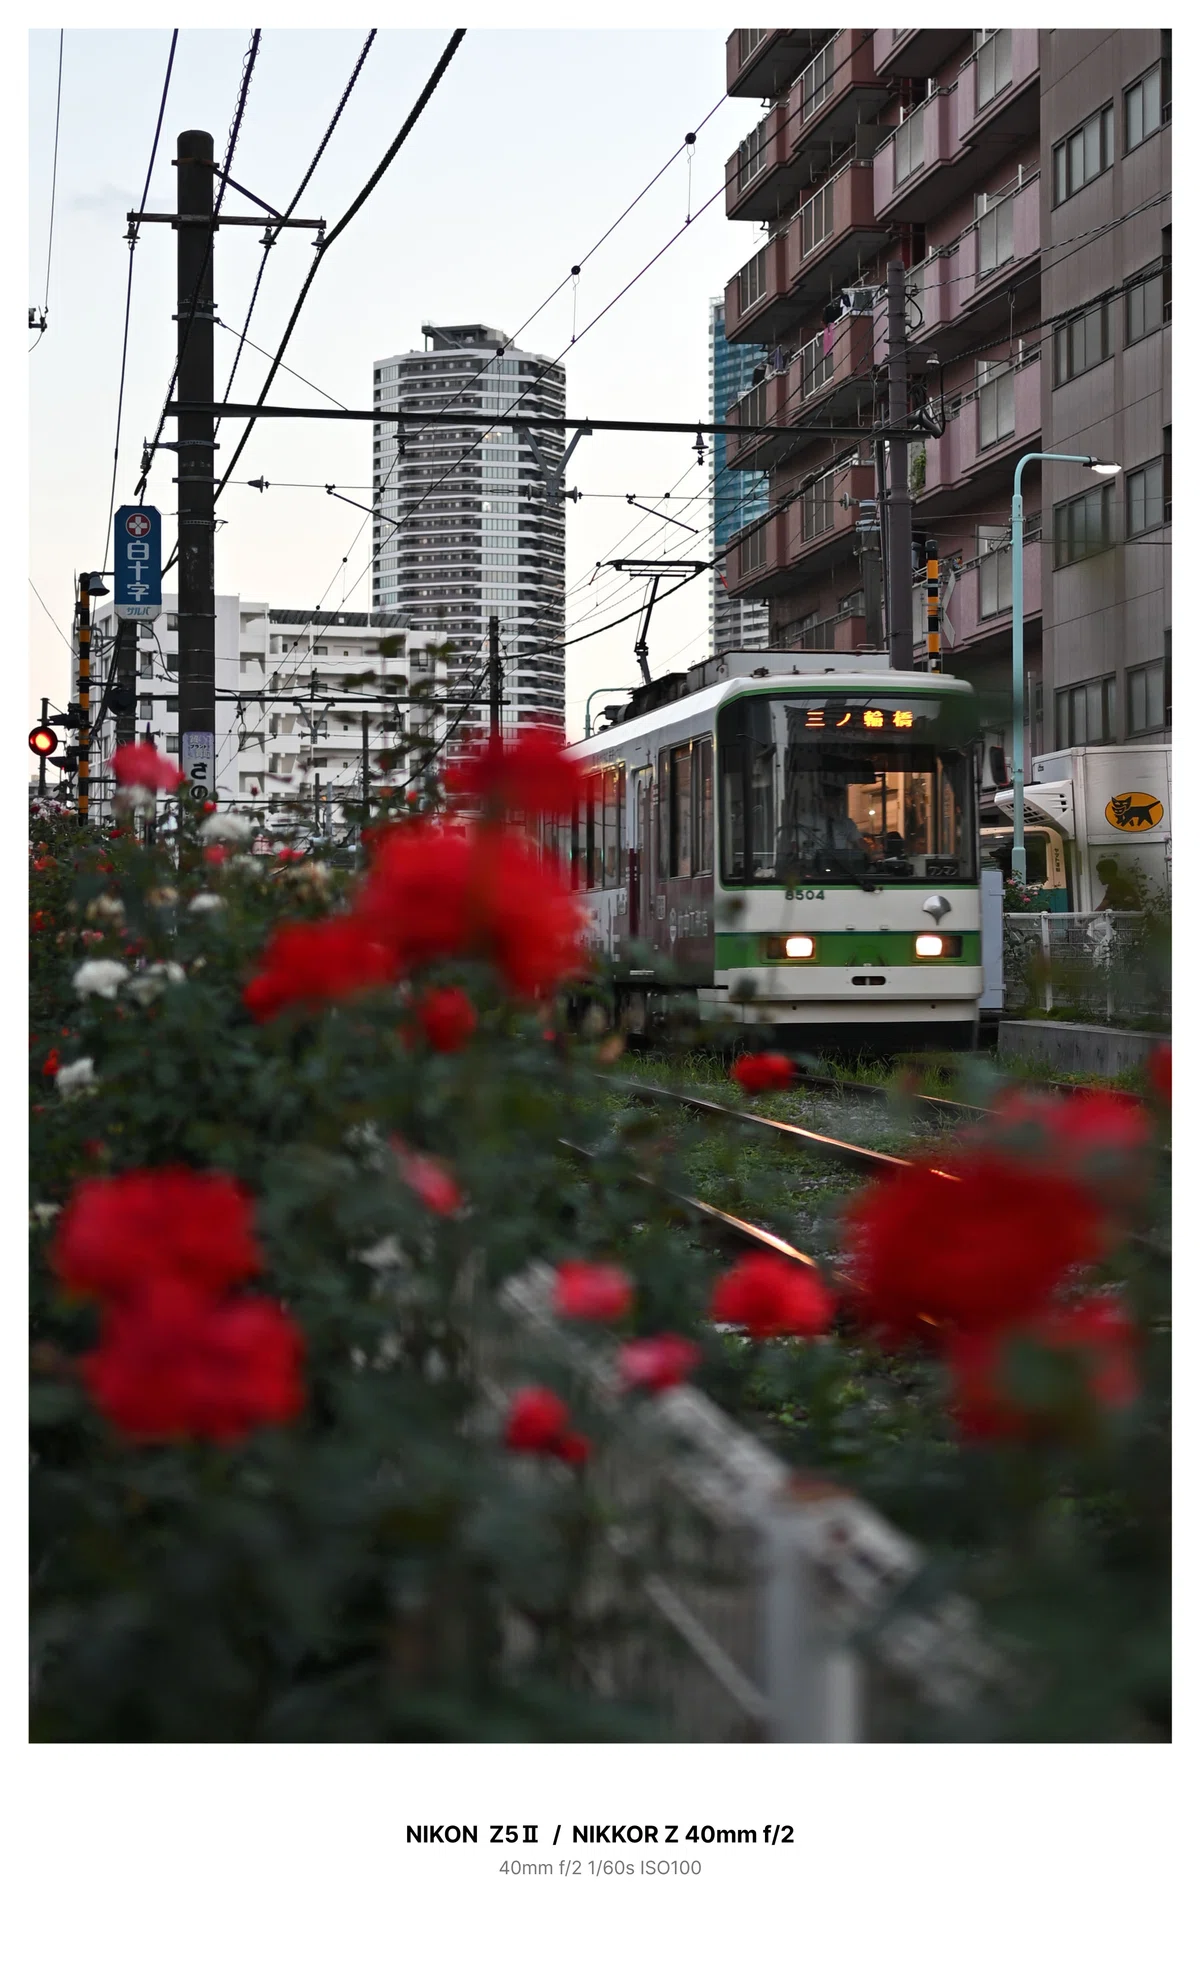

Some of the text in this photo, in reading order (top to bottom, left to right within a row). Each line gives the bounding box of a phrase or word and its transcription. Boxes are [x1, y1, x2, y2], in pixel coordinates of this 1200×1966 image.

[126, 540, 150, 602] 白十字
[805, 710, 913, 728] 三ノ輪橋
[784, 889, 825, 901] 8504
